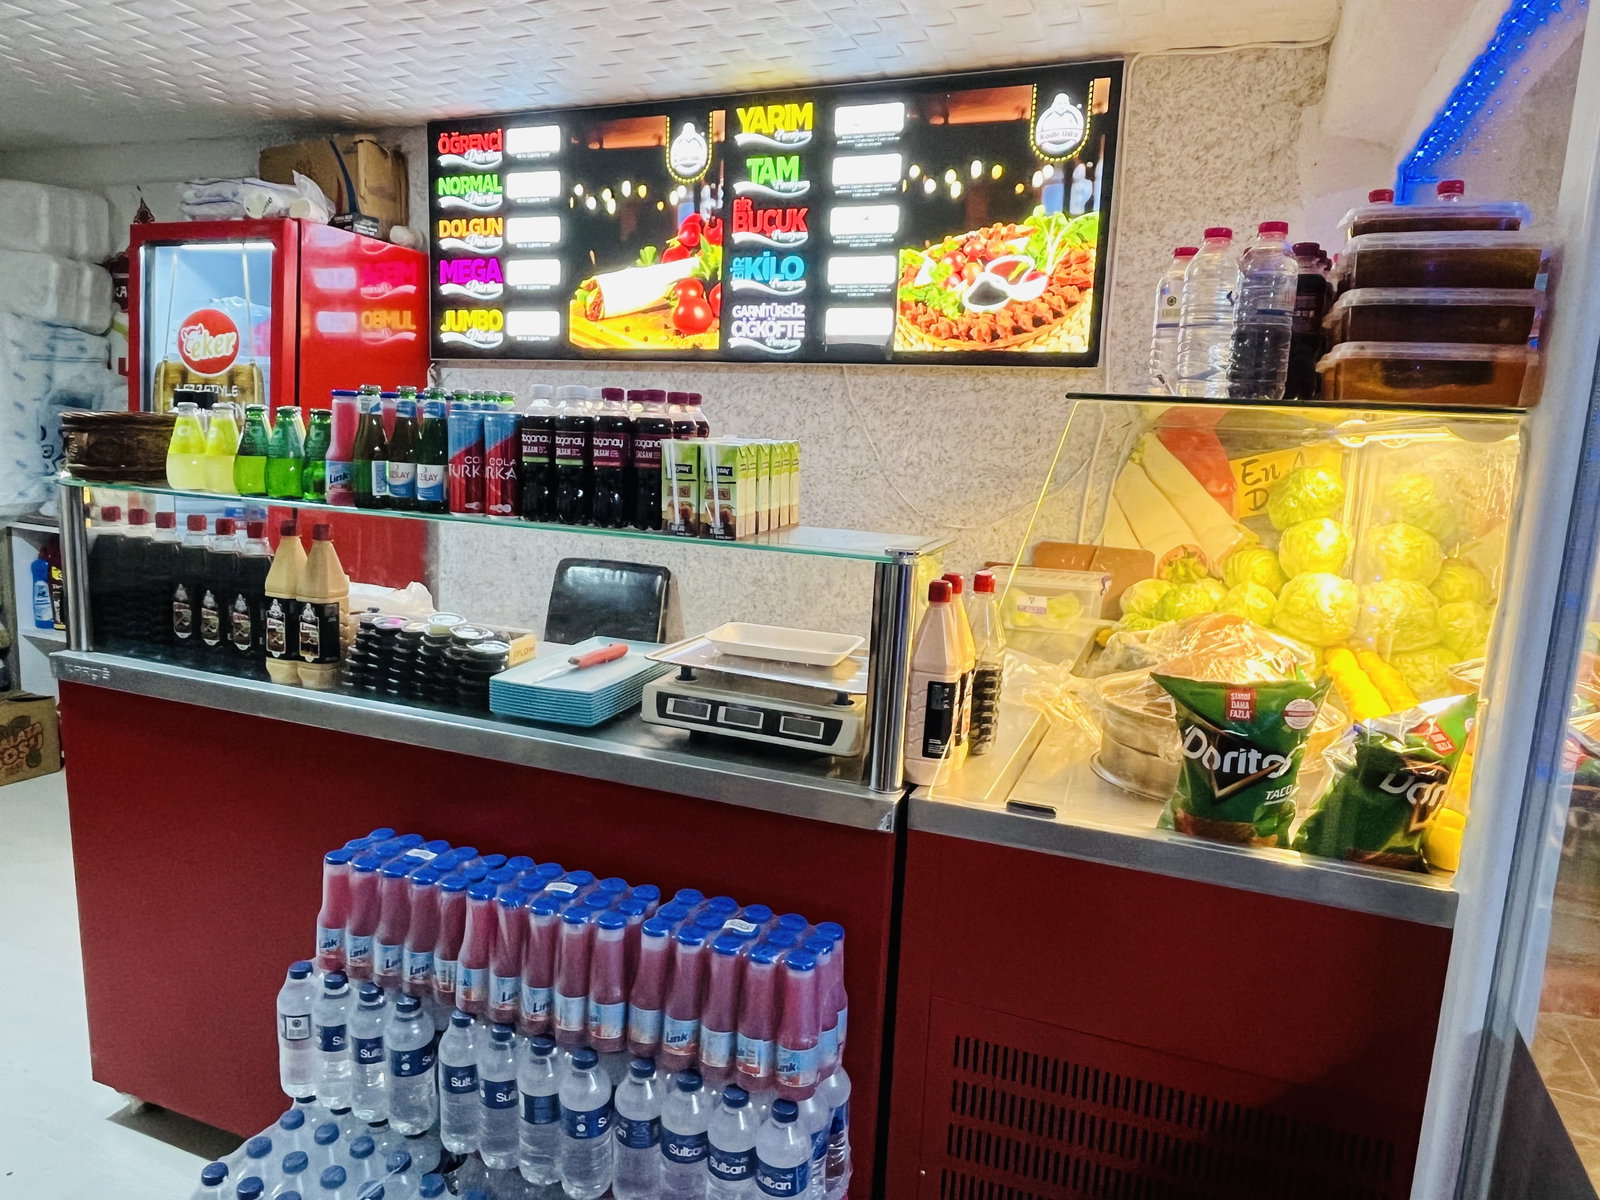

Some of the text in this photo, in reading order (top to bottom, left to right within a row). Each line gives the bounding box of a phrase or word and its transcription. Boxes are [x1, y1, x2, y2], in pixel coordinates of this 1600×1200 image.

[736, 102, 814, 135] YARIM
[437, 128, 504, 155] ÖĞRENCİ
[746, 155, 800, 185] TAM
[438, 174, 503, 196] NORMAL
[438, 217, 504, 238] DOLGUN
[732, 208, 809, 238] BUÇUK
[439, 257, 504, 285] MEGA
[744, 251, 805, 282] KİLO
[439, 309, 504, 332] JUMBO
[1241, 458, 1281, 486] En
[1231, 700, 1250, 710] DAHA
[665, 1032, 688, 1043] Link
[709, 1155, 747, 1175] Sultan
